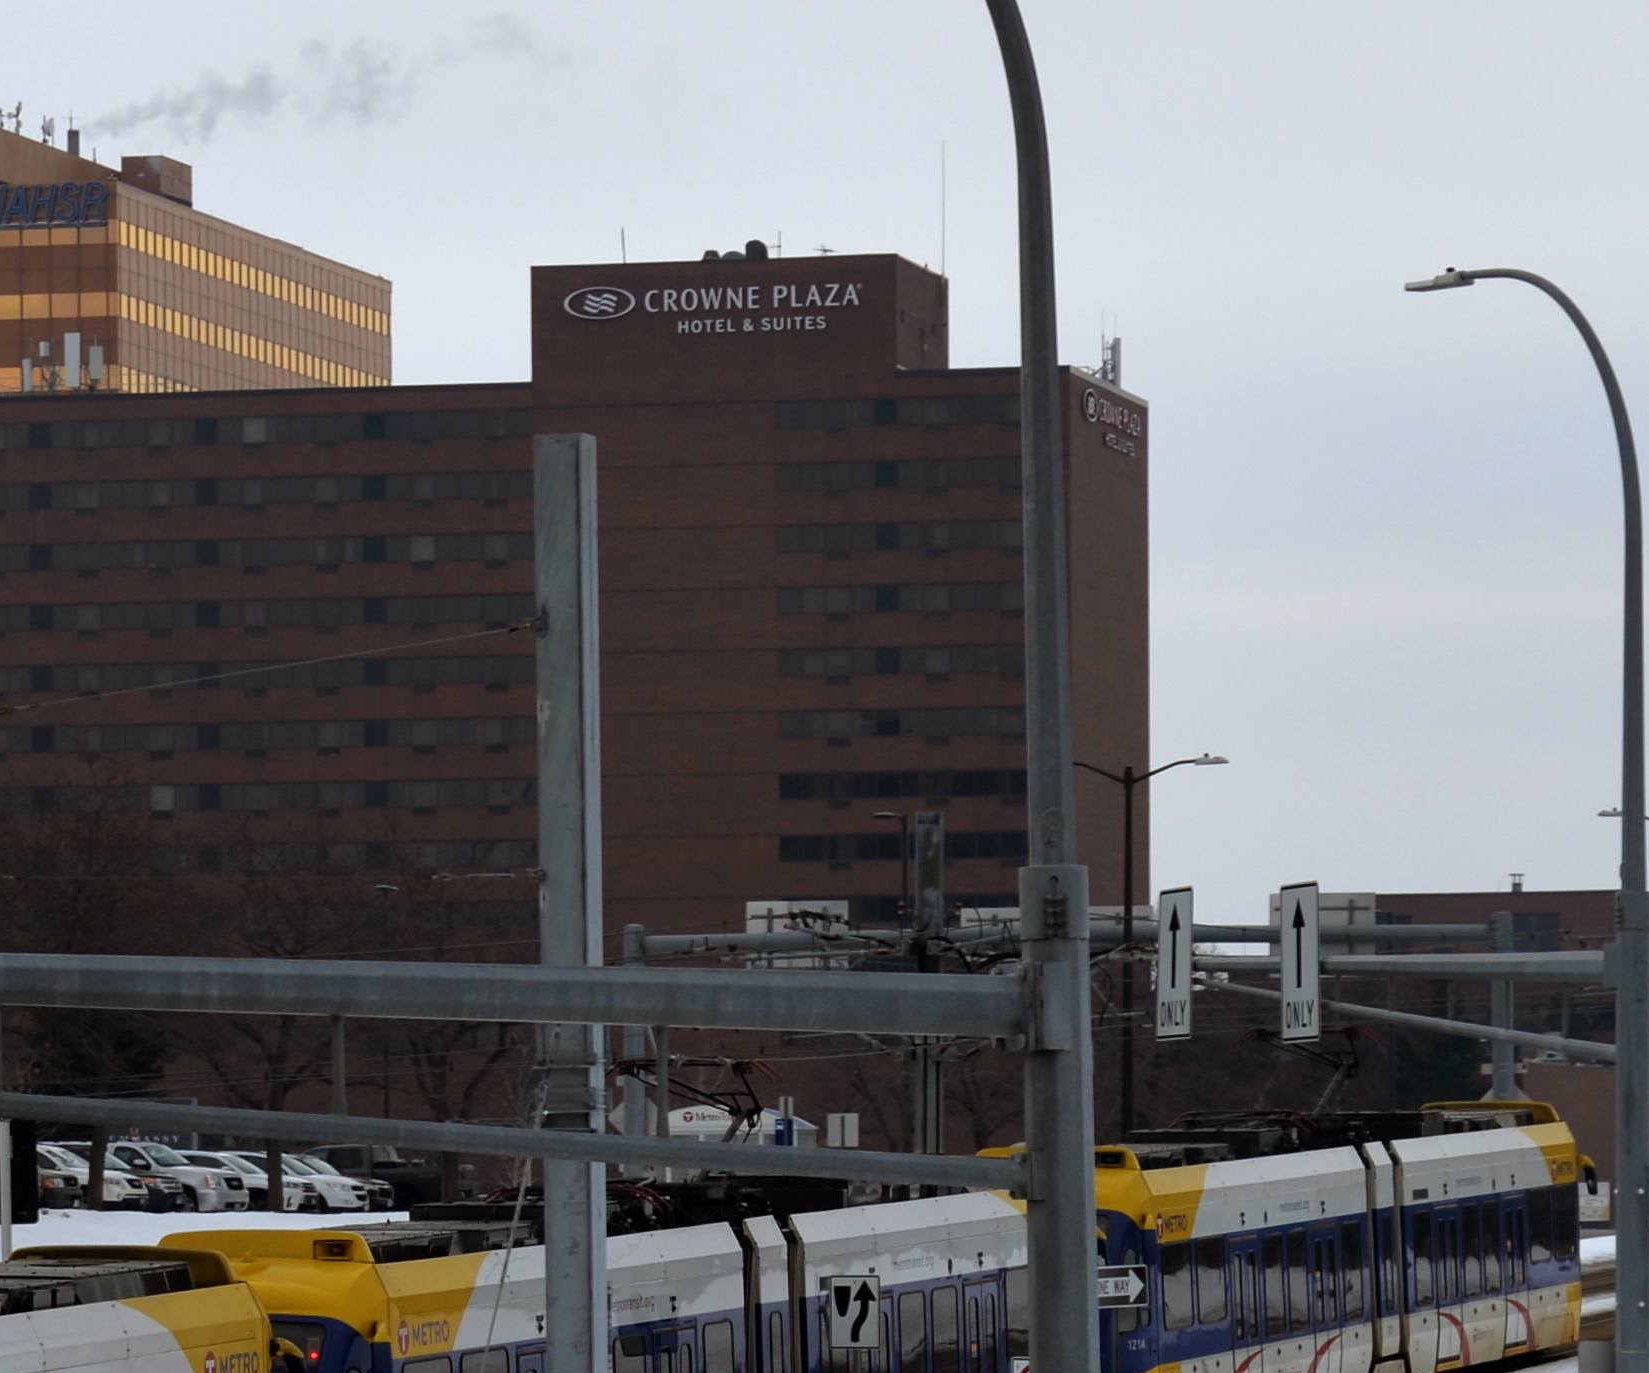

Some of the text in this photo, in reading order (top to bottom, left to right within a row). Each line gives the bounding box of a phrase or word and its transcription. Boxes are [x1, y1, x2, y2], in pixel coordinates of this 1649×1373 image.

[644, 283, 861, 312] CROWNE PLAZA
[677, 316, 828, 333] HOTEL & SUITES
[1161, 1000, 1187, 1027] ONLY
[1286, 1000, 1315, 1028] ONLY
[1114, 1279, 1130, 1295] WAY
[412, 1319, 450, 1347] METRO
